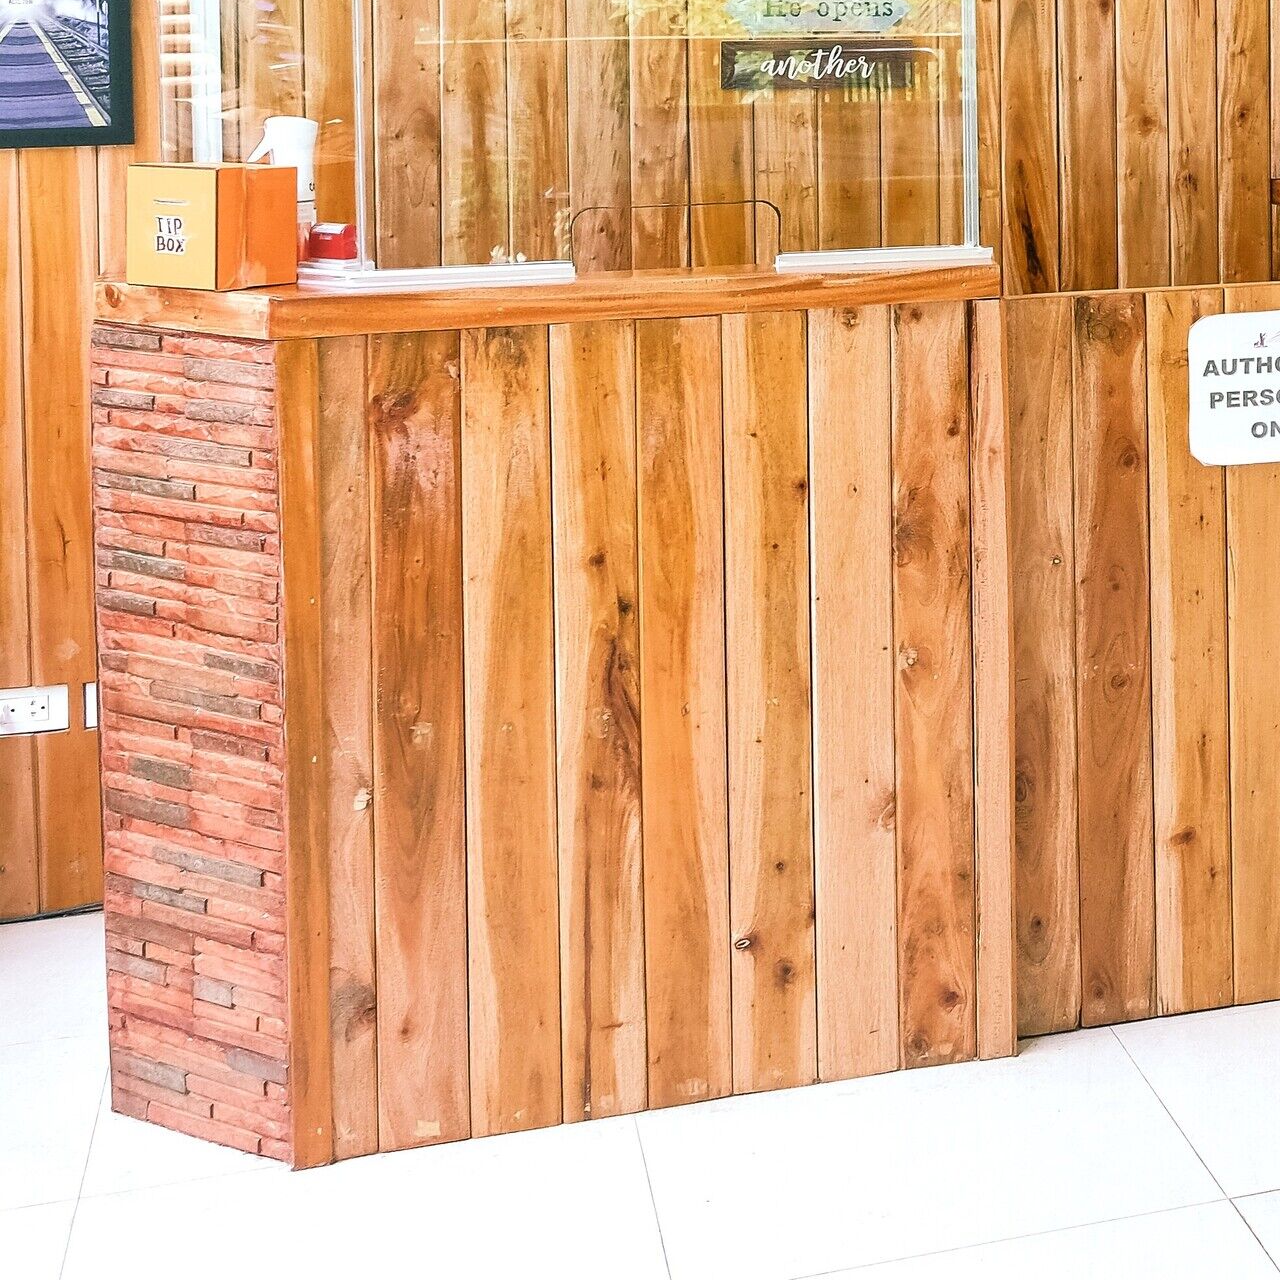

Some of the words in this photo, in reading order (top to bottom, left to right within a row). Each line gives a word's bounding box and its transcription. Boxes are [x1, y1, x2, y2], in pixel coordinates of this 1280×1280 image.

[759, 44, 877, 81] another
[155, 216, 182, 235] TIP
[156, 235, 185, 253] BOX
